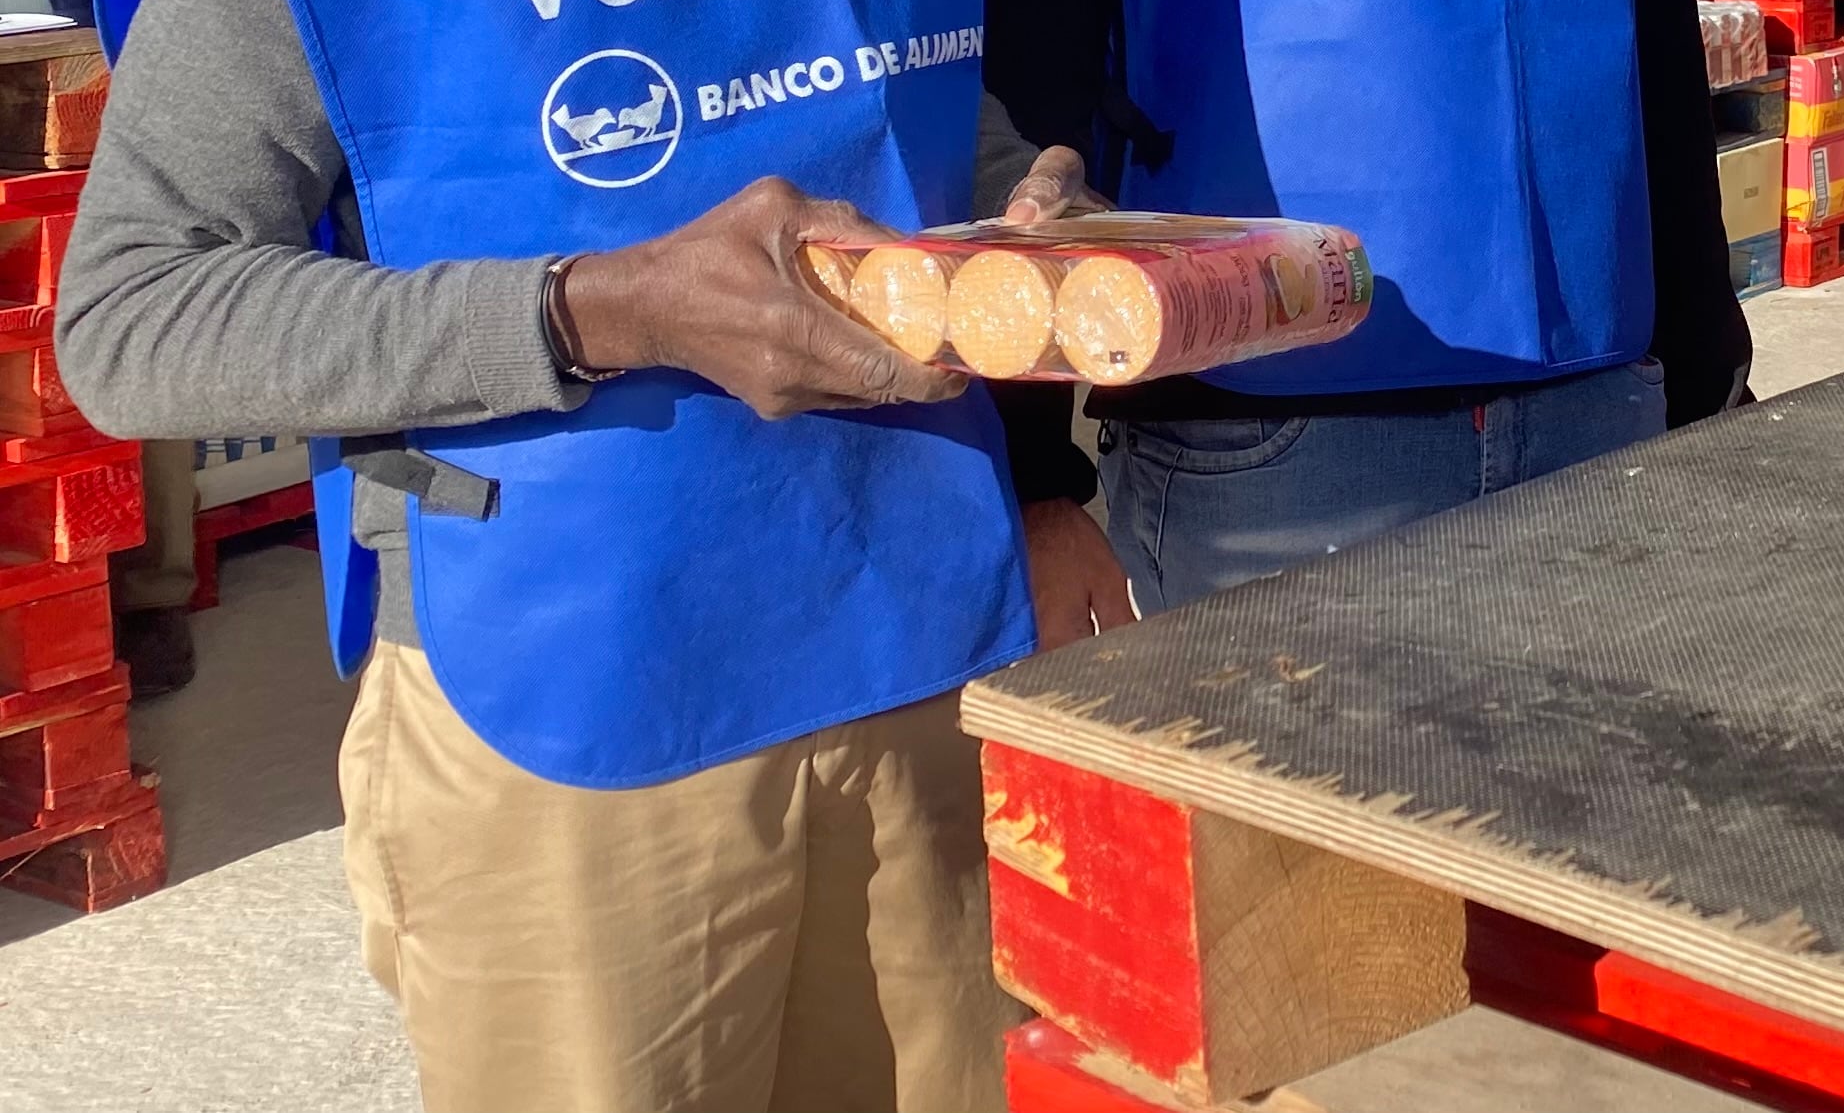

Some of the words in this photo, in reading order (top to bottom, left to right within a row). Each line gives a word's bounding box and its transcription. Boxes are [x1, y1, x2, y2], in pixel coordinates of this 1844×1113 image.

[696, 54, 844, 122] BANCO
[856, 41, 902, 84] DE
[904, 24, 984, 73] ALIMEN
